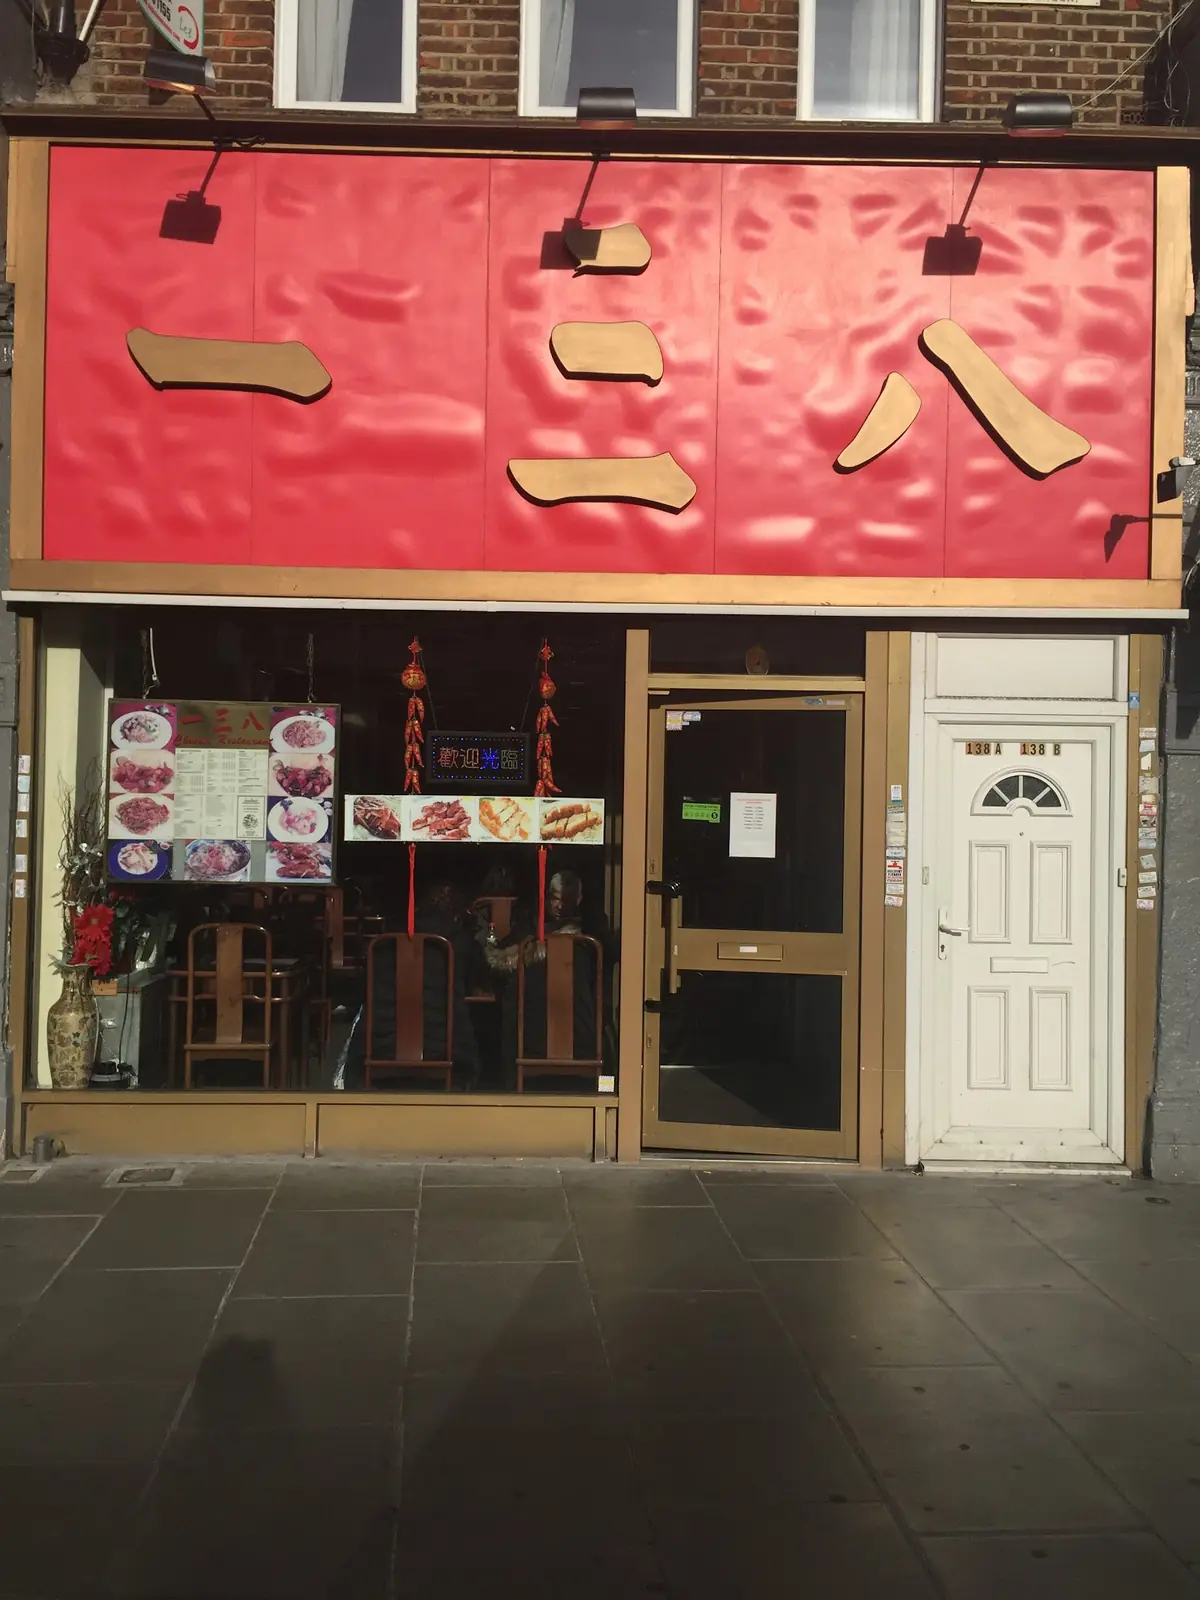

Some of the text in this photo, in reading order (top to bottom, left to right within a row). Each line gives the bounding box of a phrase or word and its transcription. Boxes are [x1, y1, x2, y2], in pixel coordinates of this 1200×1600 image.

[124, 222, 1092, 514] 一三八
[180, 707, 265, 733] 一三八
[438, 746, 519, 770] 歡迎光臨
[966, 742, 1061, 756] 138 A 138 B
